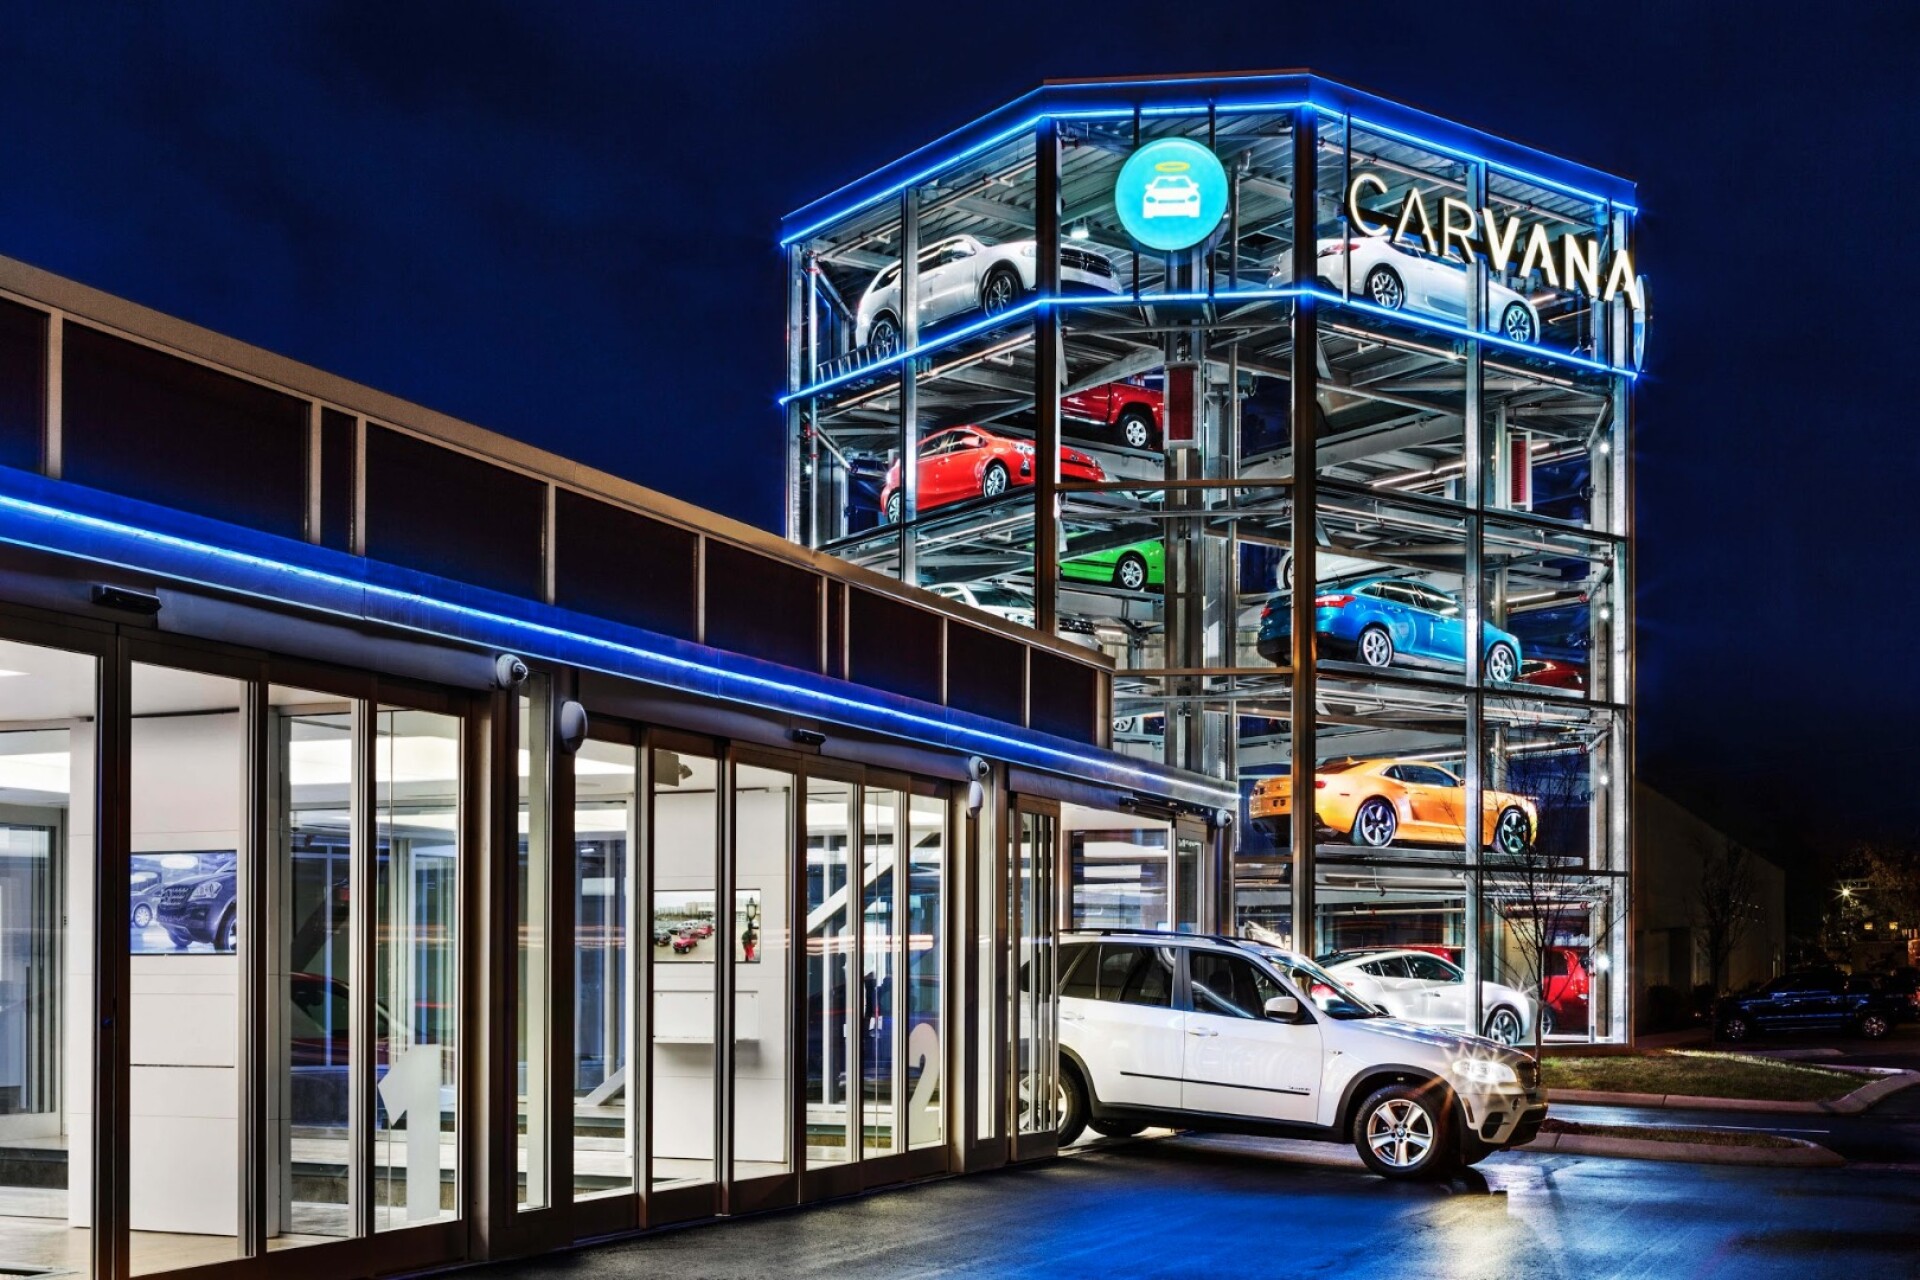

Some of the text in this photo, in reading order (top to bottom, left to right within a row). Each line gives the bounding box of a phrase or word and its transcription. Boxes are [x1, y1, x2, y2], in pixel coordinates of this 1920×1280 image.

[1348, 172, 1641, 310] CARVANA
[377, 1043, 442, 1222] 1
[908, 1022, 941, 1146] 2
